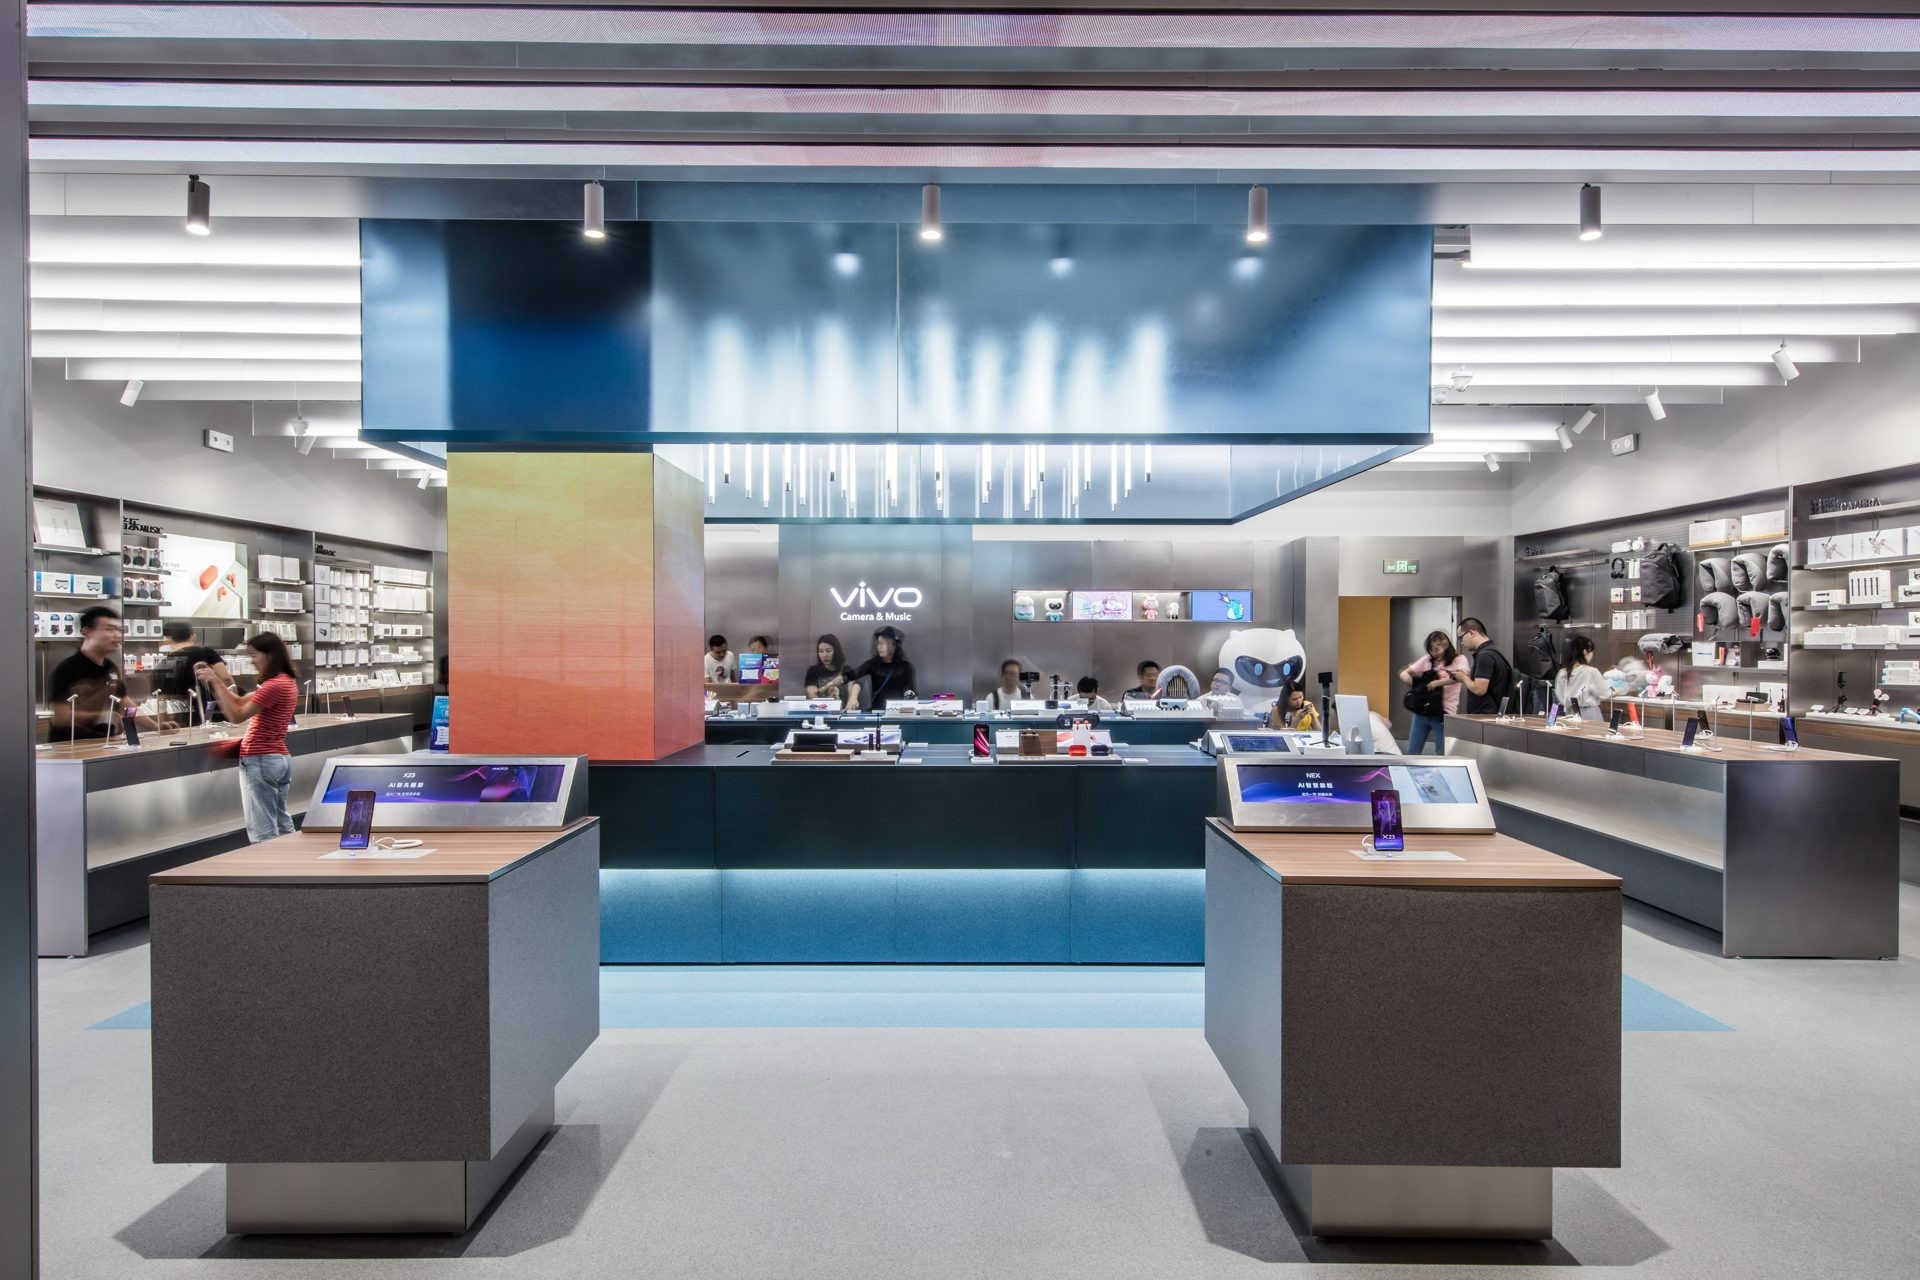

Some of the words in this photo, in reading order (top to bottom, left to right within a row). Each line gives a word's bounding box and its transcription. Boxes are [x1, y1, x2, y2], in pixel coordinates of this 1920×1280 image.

[830, 581, 922, 608] vivo
[840, 612, 874, 621] Camera
[876, 612, 884, 621] &
[885, 612, 911, 621] Music
